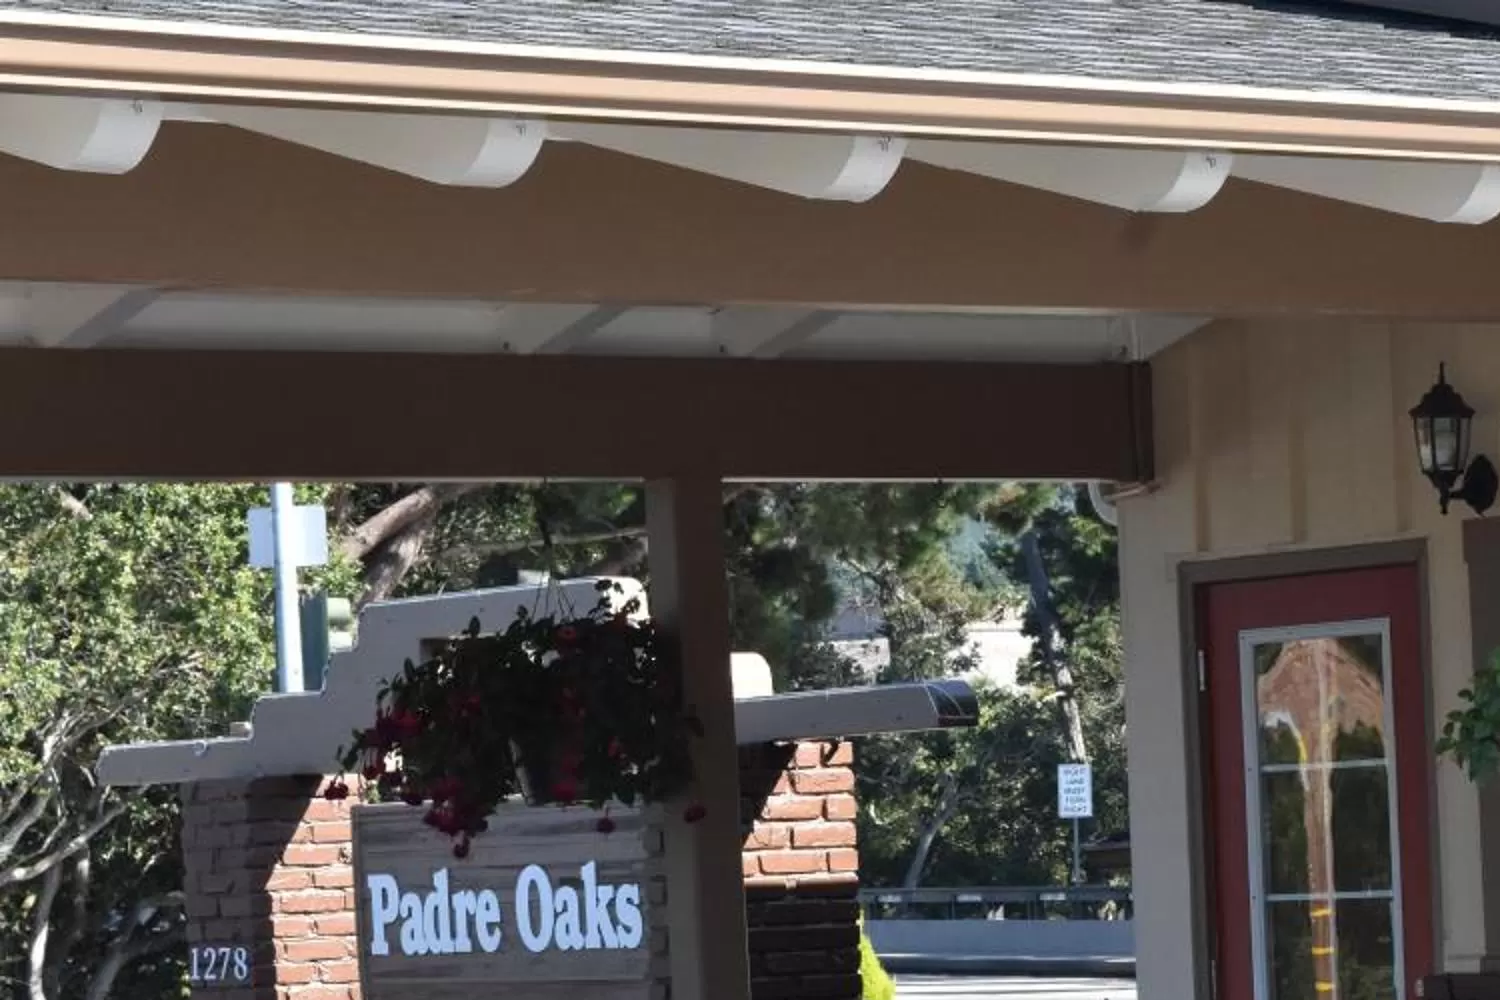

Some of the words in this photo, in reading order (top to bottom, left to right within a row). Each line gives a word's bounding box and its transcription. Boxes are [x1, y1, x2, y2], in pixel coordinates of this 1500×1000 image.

[367, 867, 501, 956] Padre
[515, 860, 643, 952] Oaks
[191, 947, 248, 980] 1278
